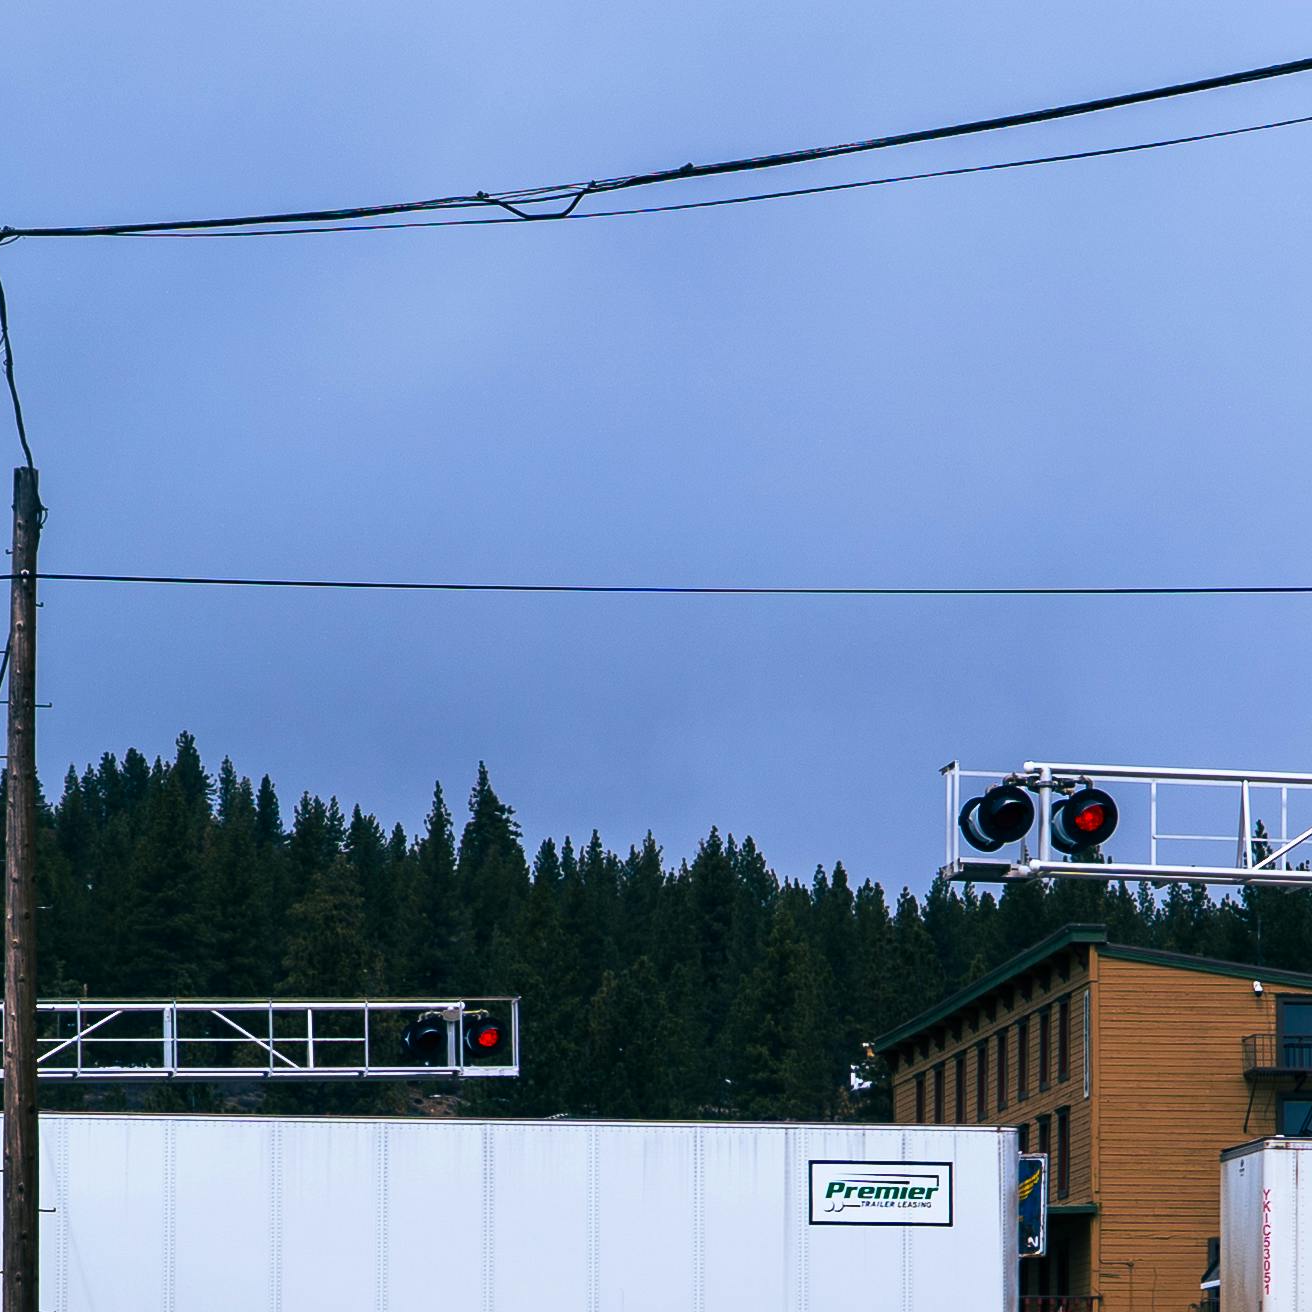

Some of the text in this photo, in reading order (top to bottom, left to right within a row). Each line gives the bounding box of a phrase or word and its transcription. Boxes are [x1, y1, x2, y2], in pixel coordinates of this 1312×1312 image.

[825, 1181, 939, 1200] Premier
[861, 1200, 932, 1209] TRAILER LEASING
